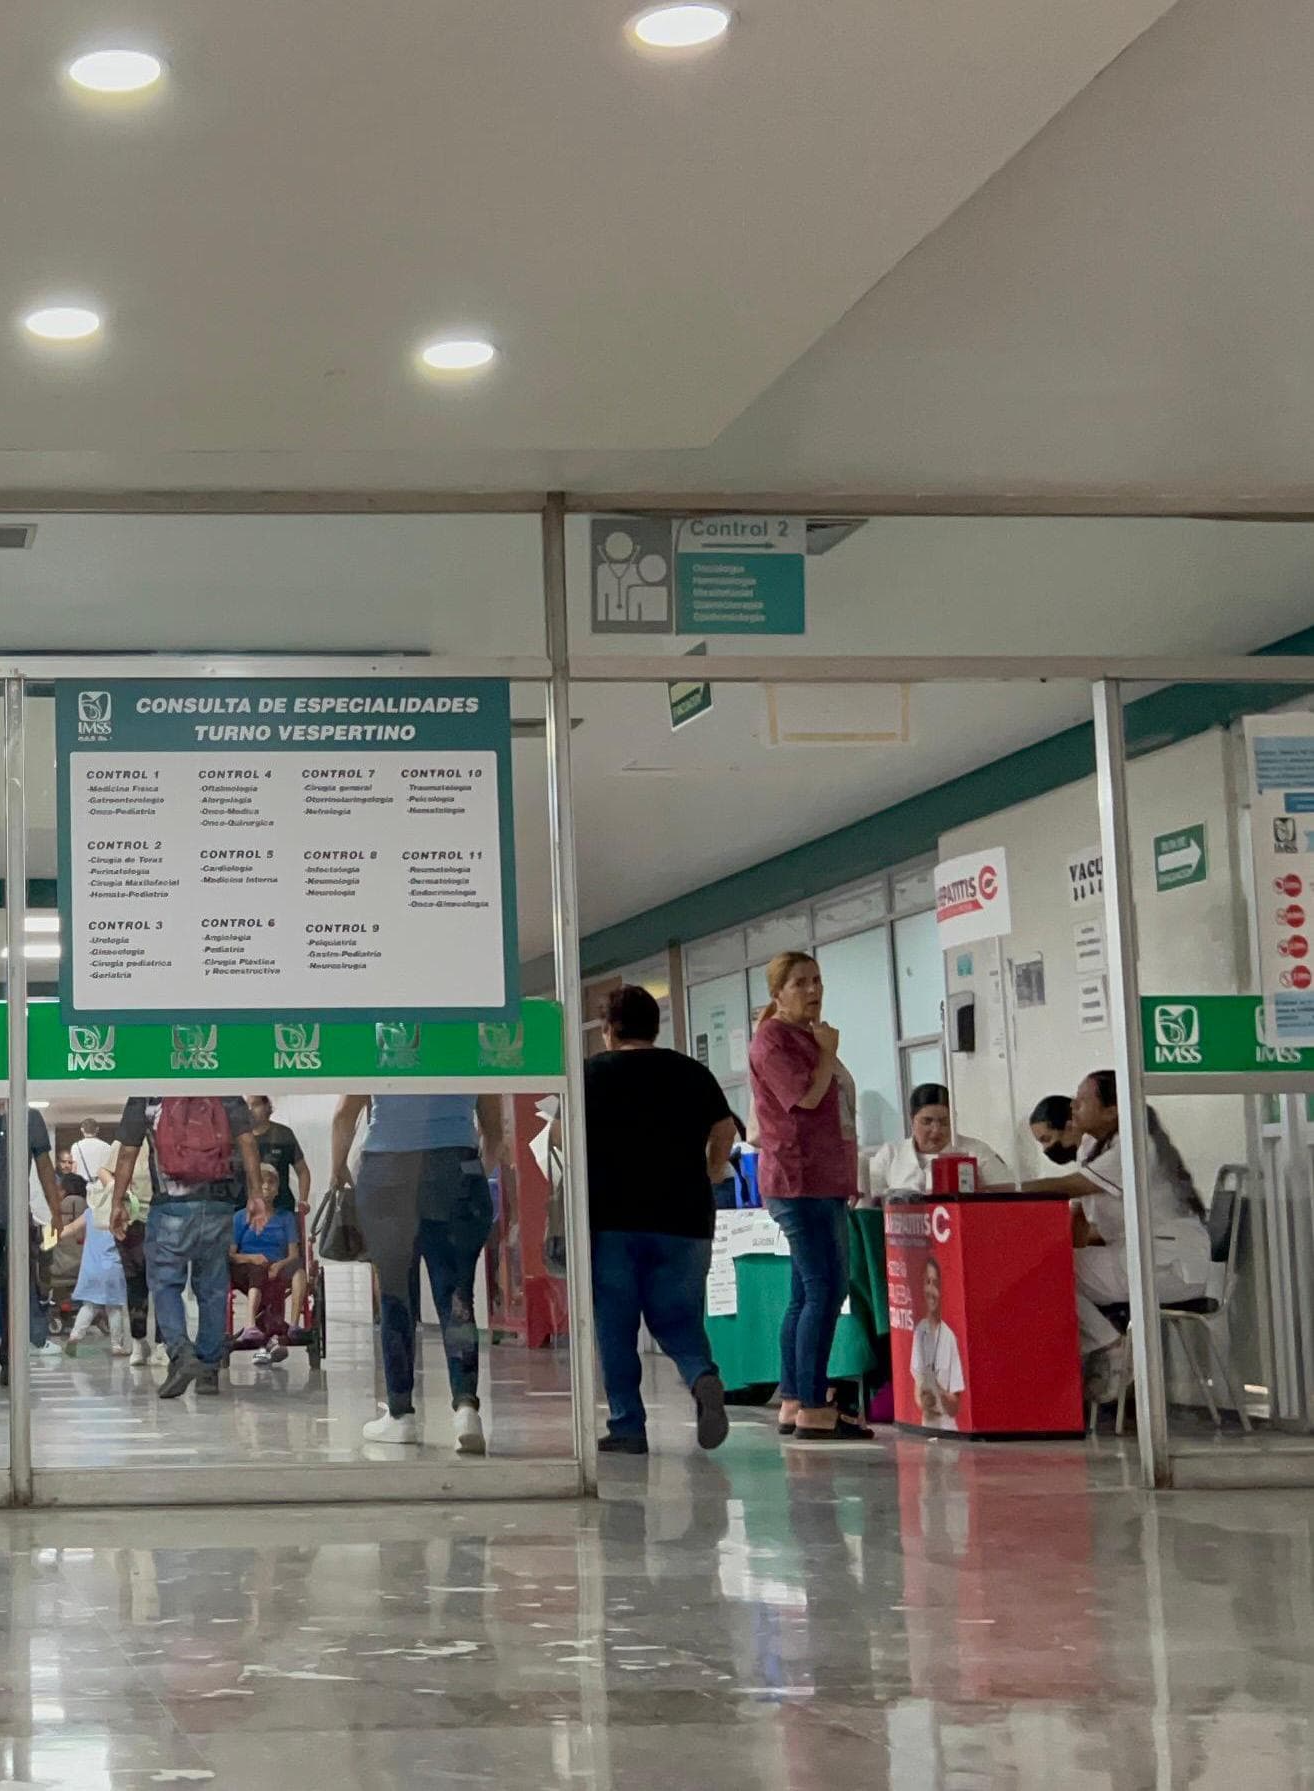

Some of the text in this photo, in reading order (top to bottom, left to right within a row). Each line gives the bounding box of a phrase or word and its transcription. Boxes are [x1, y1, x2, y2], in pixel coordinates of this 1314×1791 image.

[689, 519, 789, 537] Control 2
[135, 697, 480, 714] CONSULTA DE ESPECIALIDADES
[77, 721, 112, 736] IMSS
[194, 724, 417, 741] TURNO VESPERTINO
[85, 769, 159, 780] CONTROL 1
[197, 769, 273, 780] CONTROL 4
[301, 768, 376, 779] CONTROL 7
[400, 768, 483, 779] CONTROL 10
[86, 839, 163, 851] CONTROL 2
[199, 849, 275, 860] CONTROL 5
[303, 850, 366, 861] CONTROL
[401, 850, 483, 861] CONTROL 11
[88, 920, 164, 931] CONTROL 3
[200, 918, 276, 928] CONTROL 6
[305, 922, 380, 934] CONTROL 9
[273, 1051, 322, 1070] IMSS
[1154, 1046, 1203, 1064] IMSS
[67, 1052, 116, 1071] IMSS
[170, 1052, 219, 1071] IMSS
